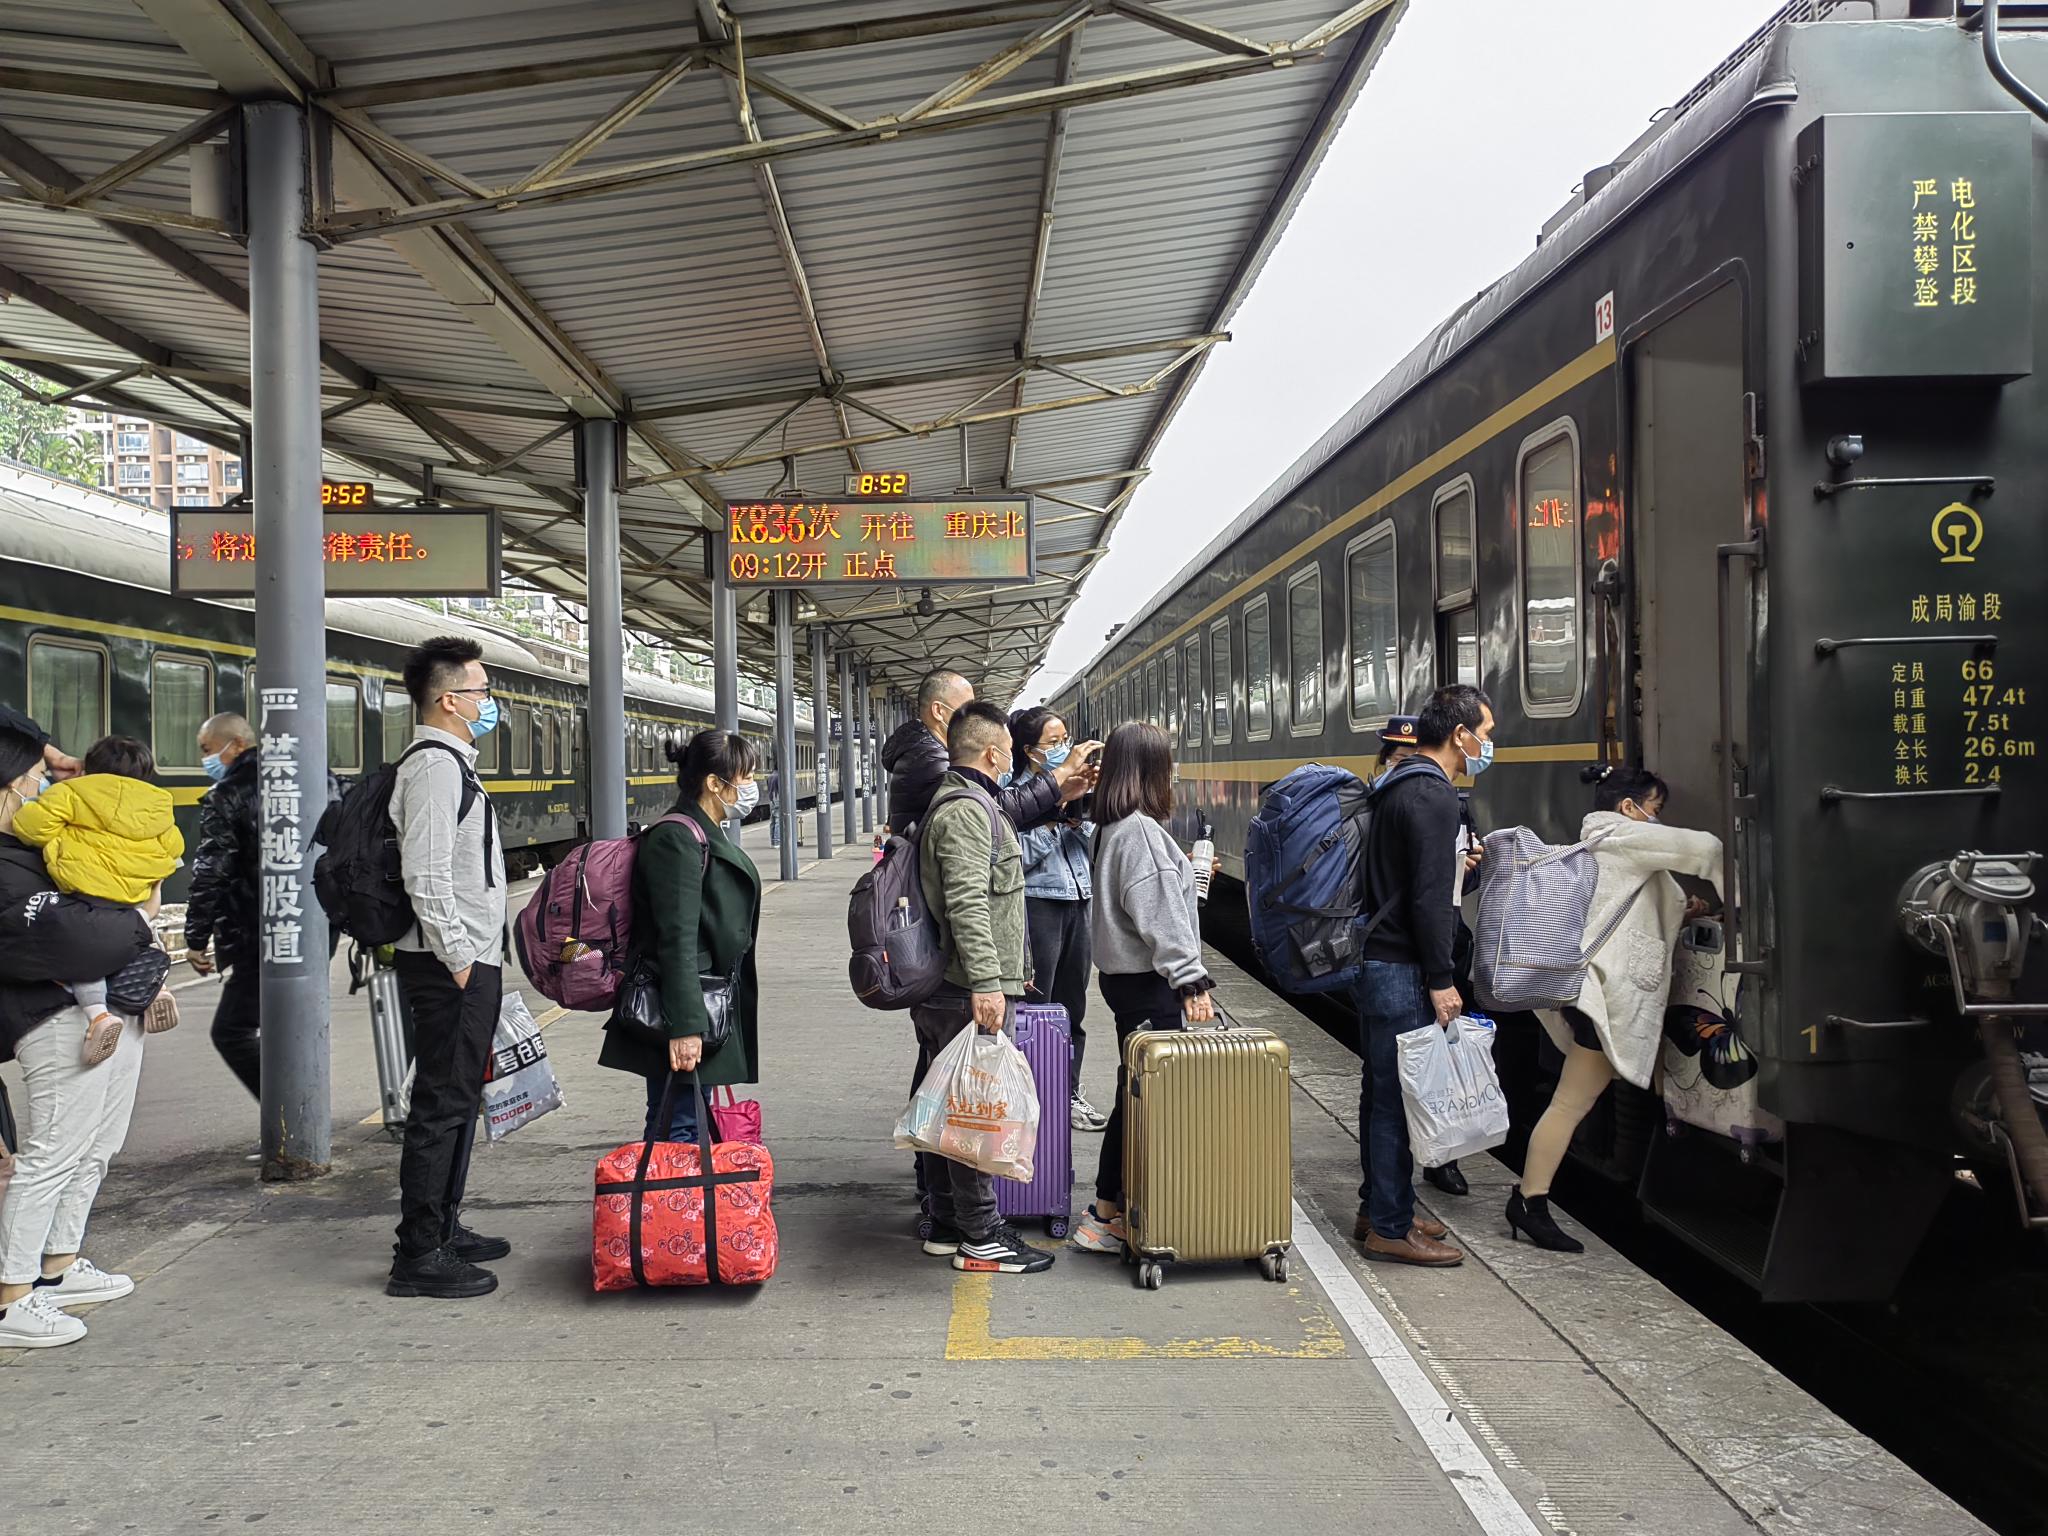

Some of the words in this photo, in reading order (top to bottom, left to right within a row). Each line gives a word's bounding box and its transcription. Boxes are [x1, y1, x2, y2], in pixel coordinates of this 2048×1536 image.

[1912, 178, 1939, 306] 严禁攀登
[1950, 177, 1977, 305] 电化区段
[1596, 299, 1612, 334] 13
[859, 474, 907, 494] 8:52
[730, 503, 841, 544] K836次
[859, 511, 916, 542] 开往
[943, 510, 1026, 540] 重庆北
[730, 552, 828, 580] 09:12开
[843, 549, 899, 579] 正点
[1911, 592, 2001, 623] 成局渝段
[1891, 662, 1925, 683] 定员
[1961, 660, 1994, 681] 66
[1894, 687, 1926, 709] 自重
[1962, 685, 2026, 706] 47.4t
[1893, 713, 1927, 734] 载重
[1963, 711, 2009, 732] 7.5t
[1894, 738, 1928, 760] 全长
[1964, 736, 2036, 757] 26.6m
[1895, 765, 1929, 785] 换长
[1964, 763, 2001, 783] 2.4
[260, 687, 304, 964] 严禁横越股道
[1800, 1025, 1817, 1053] 1
